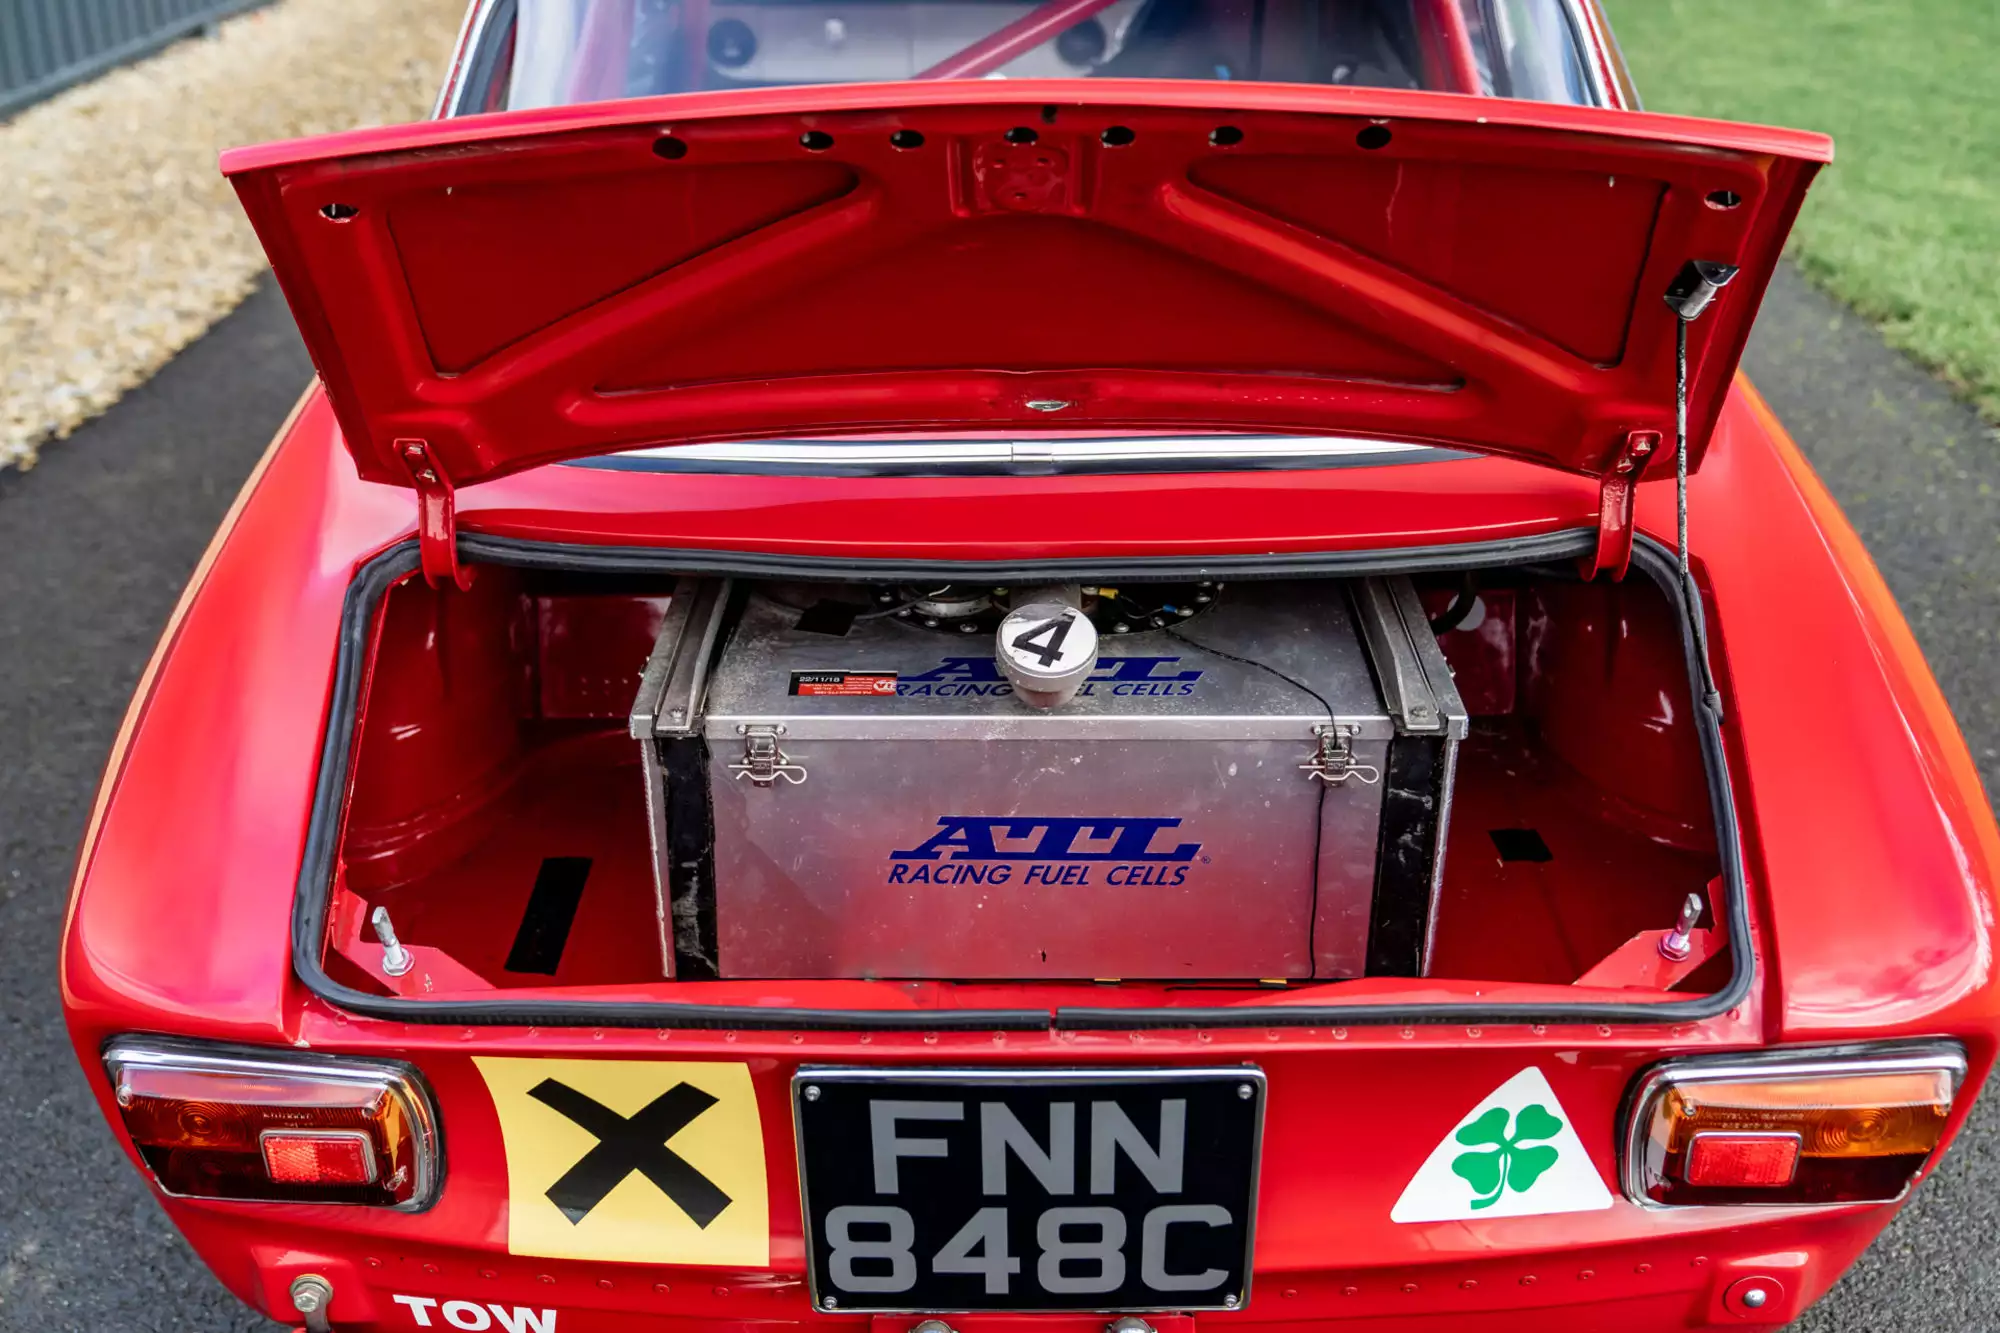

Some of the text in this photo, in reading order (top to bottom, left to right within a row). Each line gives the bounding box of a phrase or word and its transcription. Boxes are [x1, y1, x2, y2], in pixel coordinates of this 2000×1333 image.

[1011, 613, 1077, 668] 4
[896, 683, 1013, 697] RACING
[1112, 682, 1195, 697] CELLS
[898, 656, 1204, 682] AL
[888, 815, 1203, 862] ATL
[888, 863, 1191, 887] RACING FUEL CELLS
[869, 1098, 1187, 1196] FNN
[824, 1203, 1234, 1295] 848C
[392, 1294, 557, 1333] TOW
